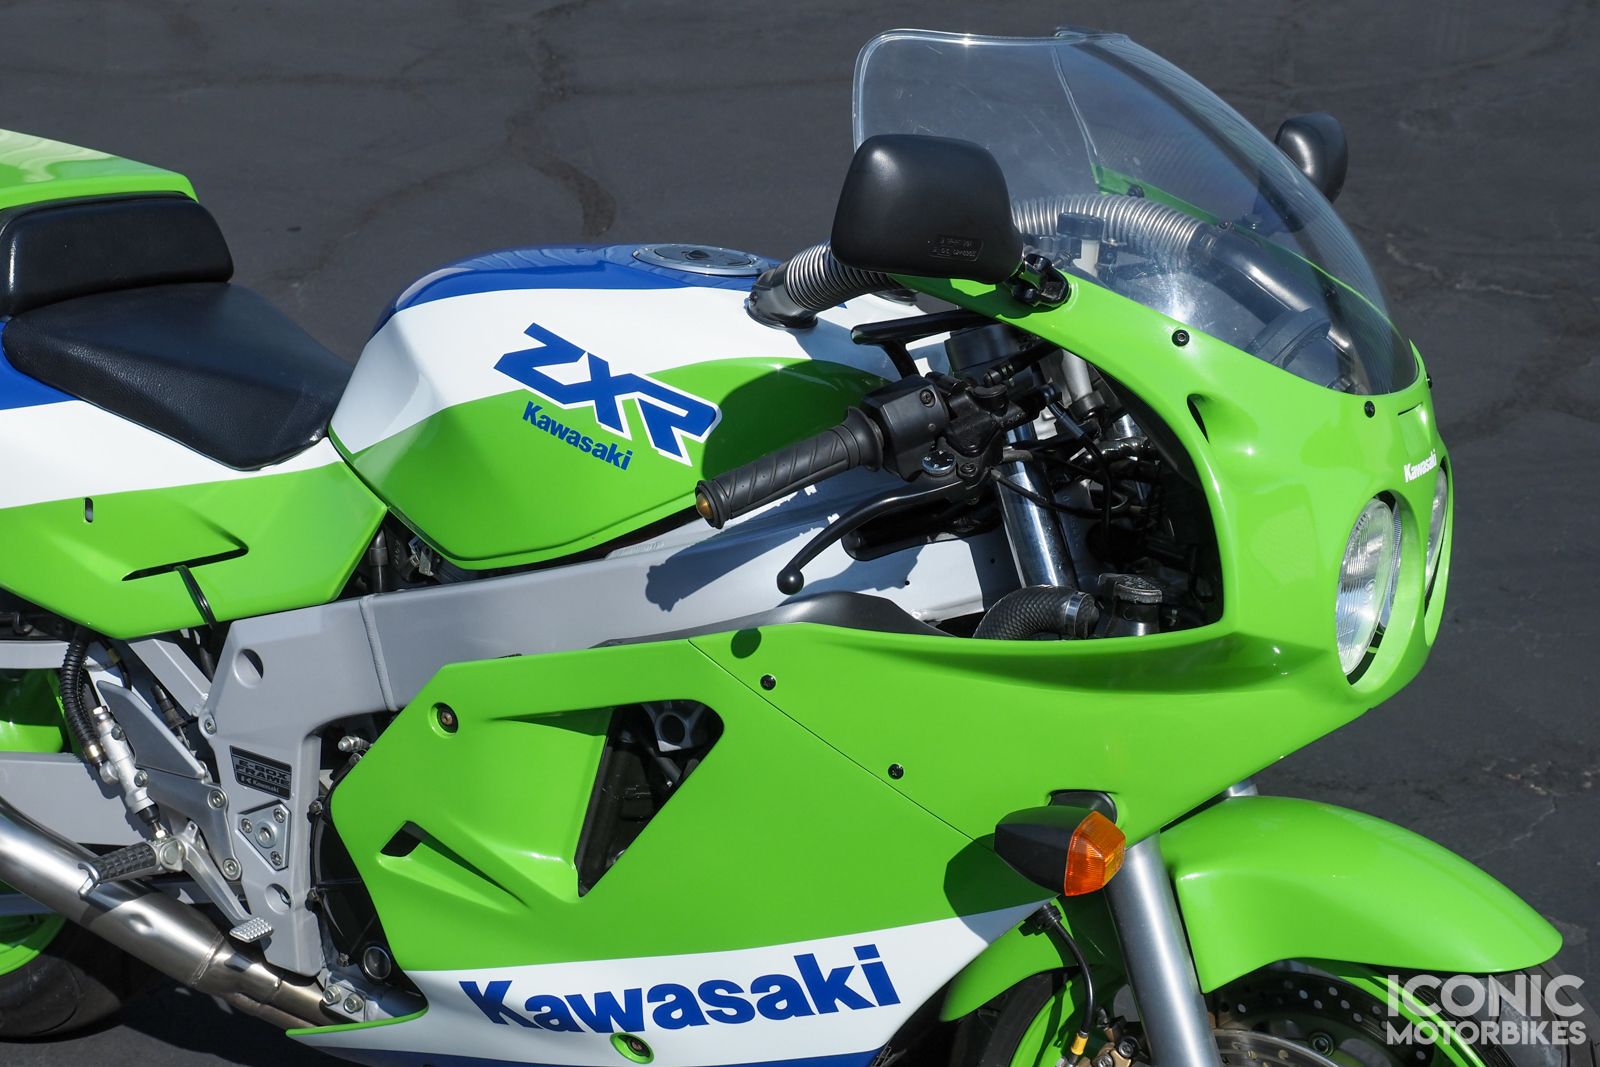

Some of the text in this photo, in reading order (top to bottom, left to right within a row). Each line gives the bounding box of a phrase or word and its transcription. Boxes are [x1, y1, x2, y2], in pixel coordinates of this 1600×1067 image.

[493, 322, 719, 461] ZXR
[522, 401, 633, 471] Kawasaki
[1403, 448, 1437, 483] Kawasaki
[236, 764, 290, 785] FRAME
[458, 943, 901, 1033] Kawasaki
